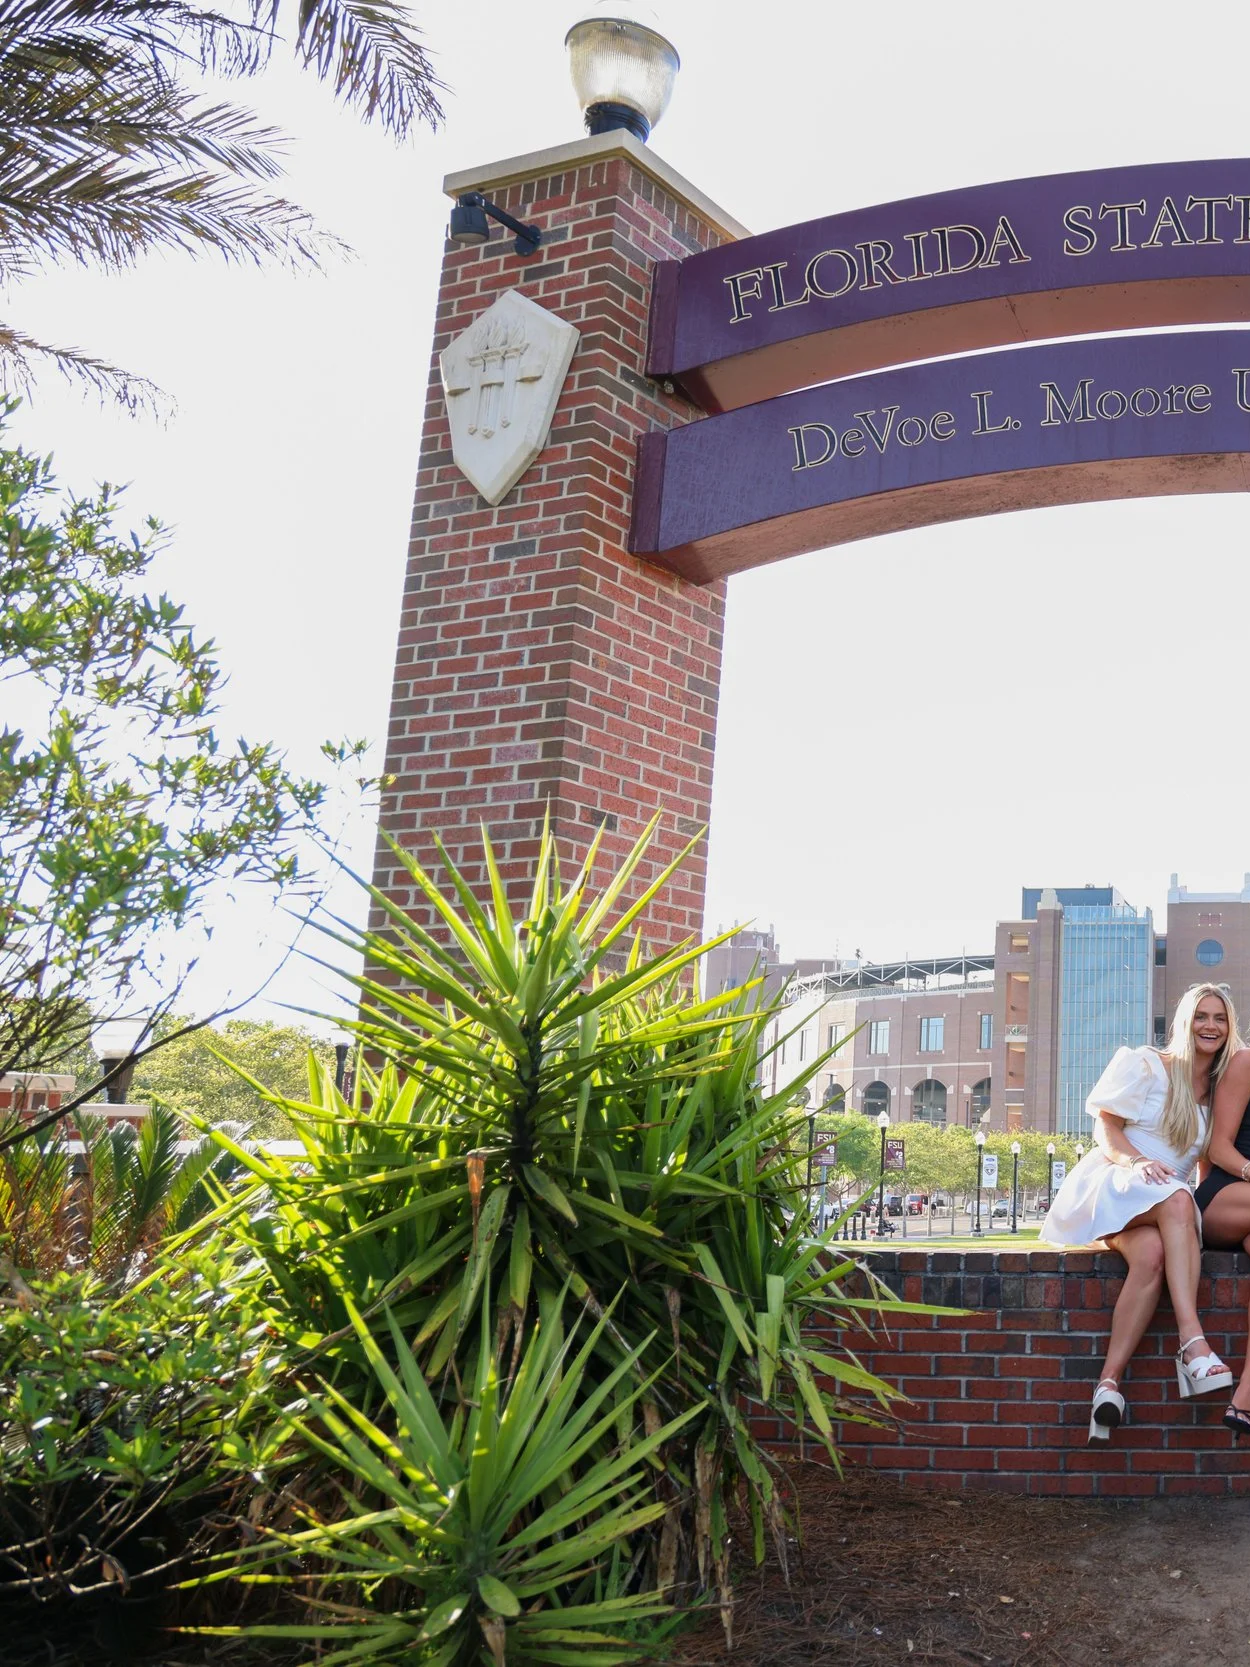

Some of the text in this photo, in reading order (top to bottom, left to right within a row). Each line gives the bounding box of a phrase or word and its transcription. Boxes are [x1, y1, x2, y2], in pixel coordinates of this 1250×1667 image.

[723, 216, 1031, 323] FLORIDA
[788, 406, 955, 471] DeVoe
[971, 391, 1022, 435] L.
[1040, 379, 1211, 426] Moore
[817, 1133, 835, 1142] FSU
[887, 1141, 903, 1149] FSU
